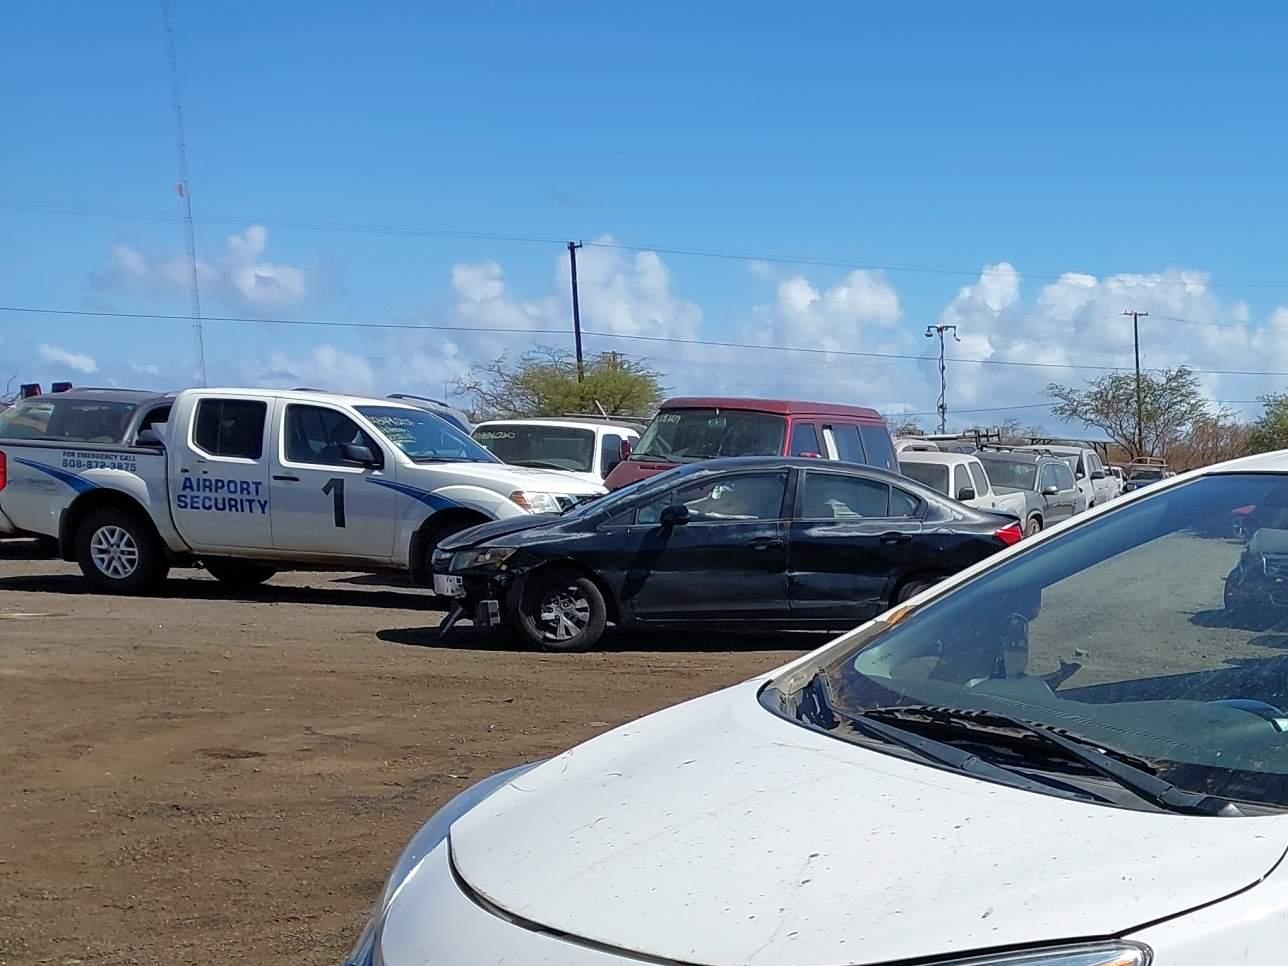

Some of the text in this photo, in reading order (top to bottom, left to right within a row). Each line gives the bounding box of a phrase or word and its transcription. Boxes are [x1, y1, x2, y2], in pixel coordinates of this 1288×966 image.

[62, 458, 137, 472] 808-872-3875
[77, 452, 118, 461] EMERGENCY
[119, 454, 136, 462] CALL
[182, 477, 262, 496] AIRPORT
[177, 494, 268, 514] SECURITY
[321, 477, 346, 528] 1
